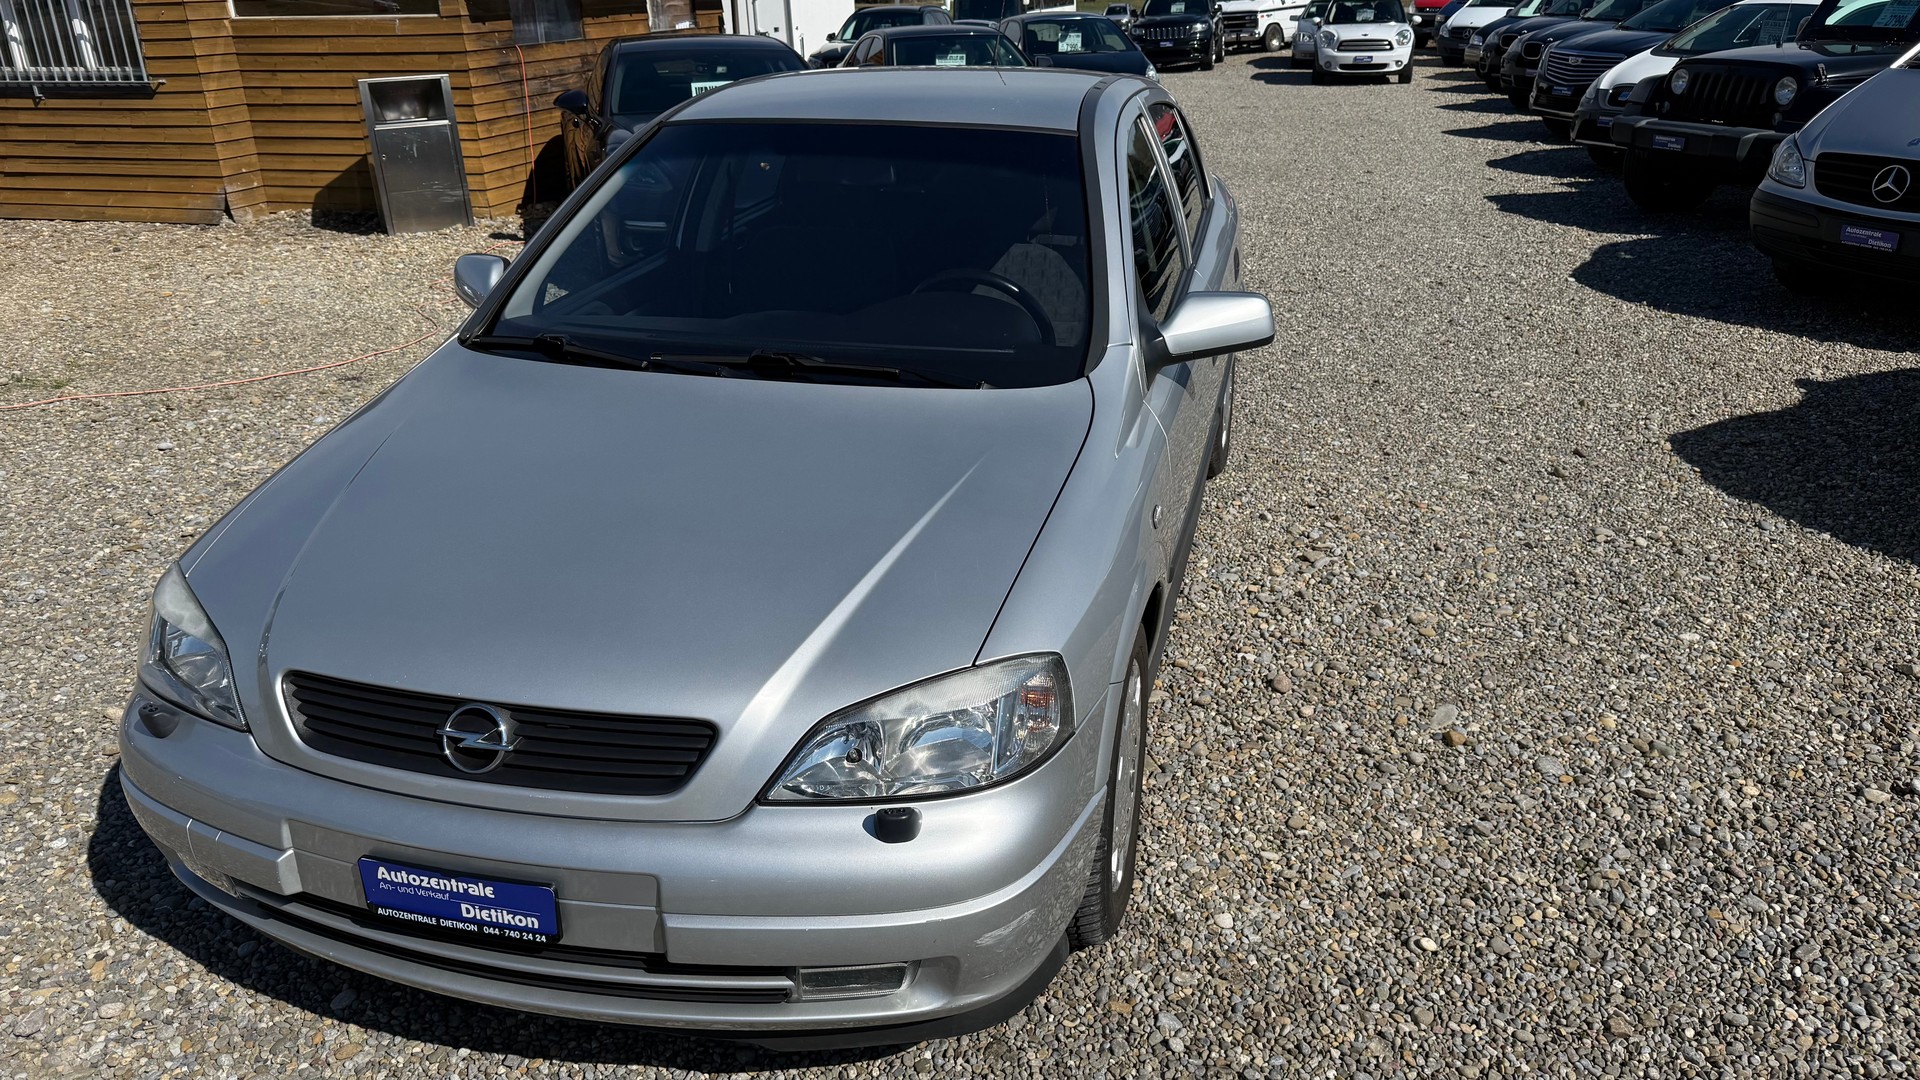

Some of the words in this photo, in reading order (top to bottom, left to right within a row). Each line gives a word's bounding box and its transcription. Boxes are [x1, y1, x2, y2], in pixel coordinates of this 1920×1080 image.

[377, 866, 495, 898] Autozentrale
[379, 881, 396, 891] An-
[397, 886, 414, 895] und
[415, 887, 450, 901] Verkauf
[377, 907, 437, 925] AUTOZENTRALE
[440, 918, 478, 932] DIETIKON
[522, 932, 534, 941] 24
[535, 934, 547, 943] 24
[460, 903, 539, 929] Dietikon
